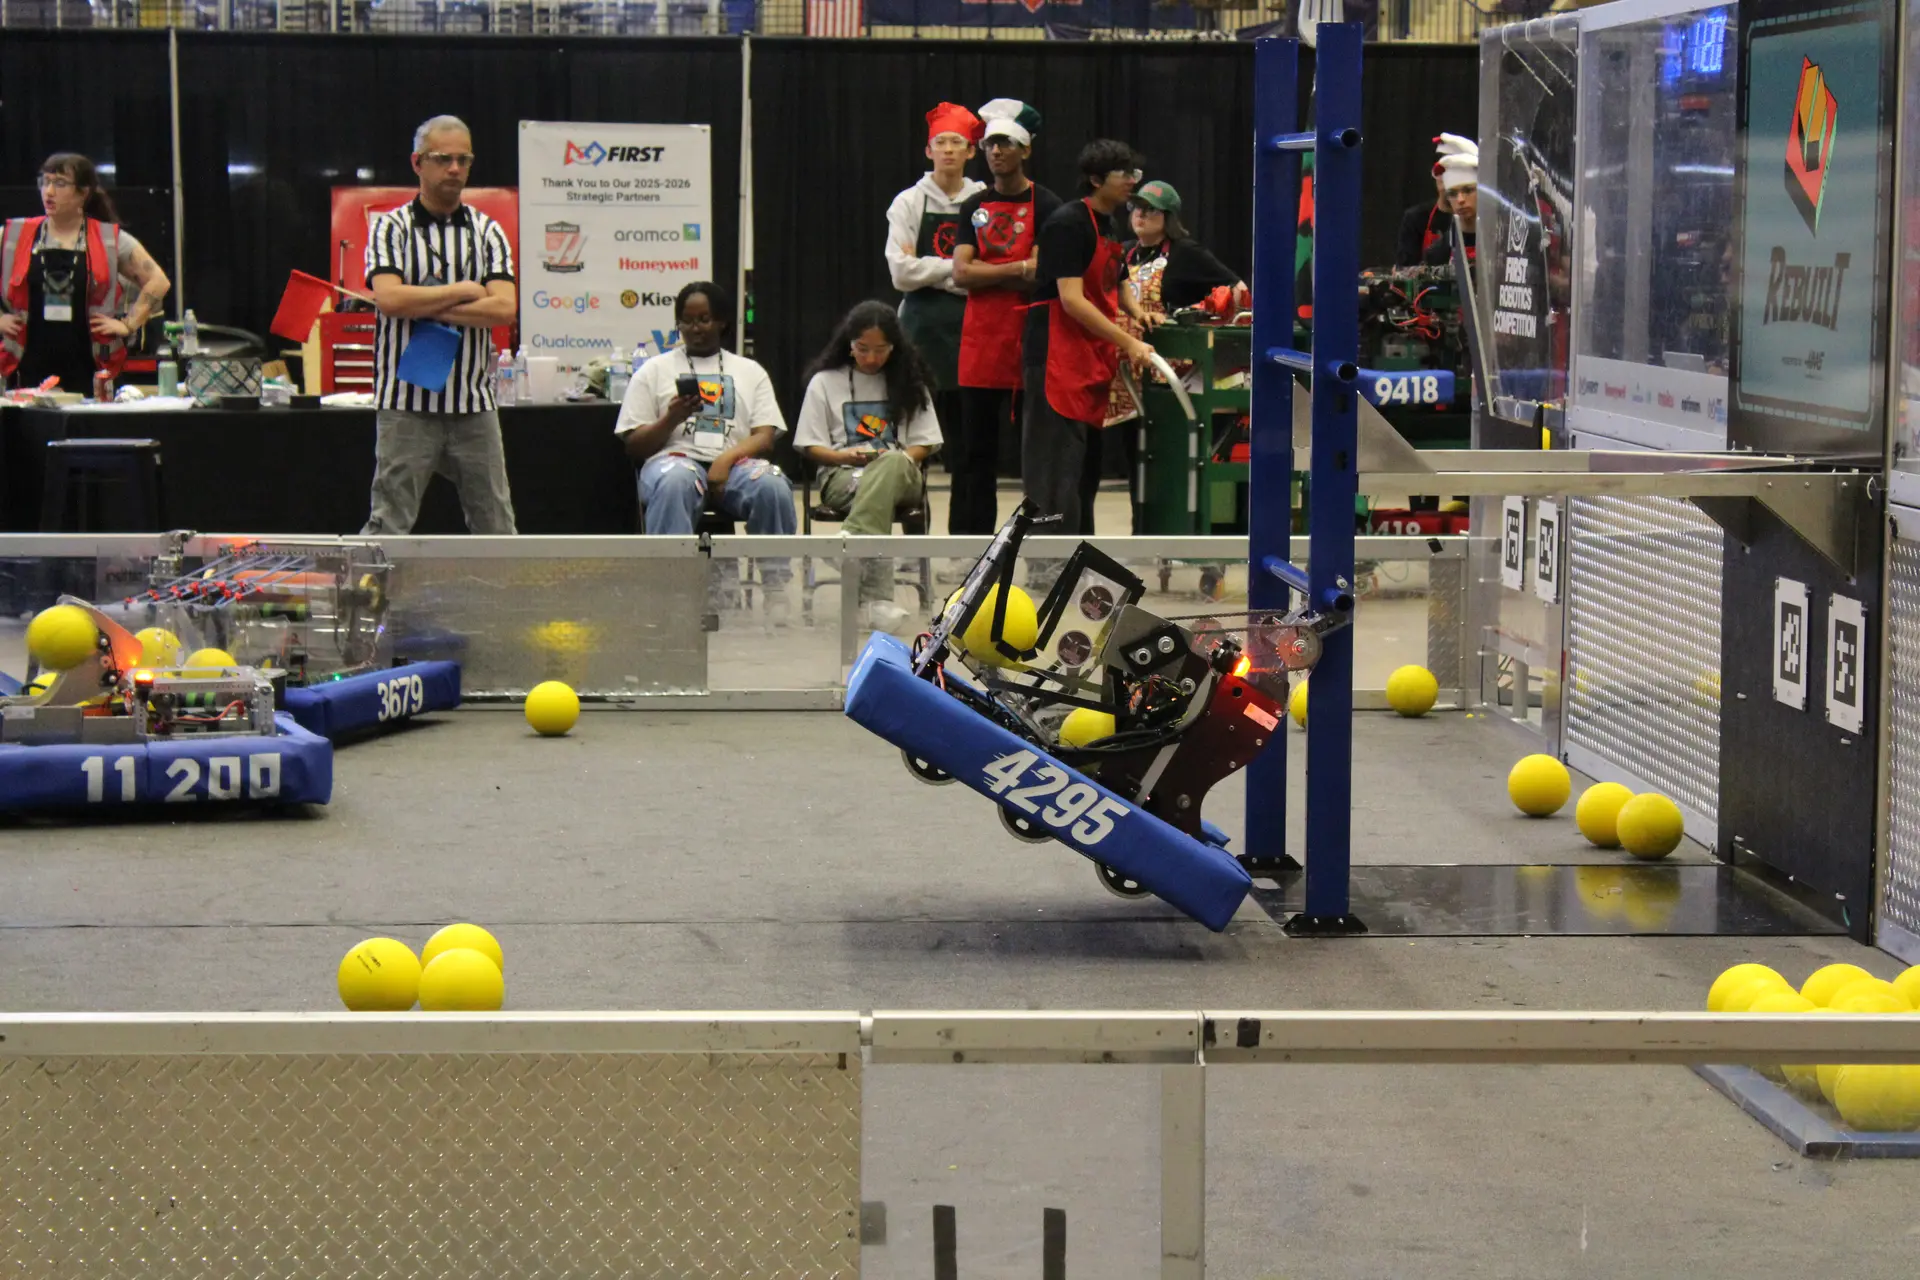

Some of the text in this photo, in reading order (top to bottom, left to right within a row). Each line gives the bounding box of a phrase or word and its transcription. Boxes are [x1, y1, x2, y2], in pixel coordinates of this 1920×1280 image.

[607, 147, 665, 162] FIRST
[541, 178, 691, 189] Thank You to Our 2025-2026
[566, 191, 661, 203] Strategic Partners
[614, 229, 680, 242] aramco
[619, 257, 698, 273] Honeywell
[1505, 256, 1528, 284] FIRST
[533, 290, 600, 313] Google
[1499, 284, 1532, 311] ROBOTICS
[1494, 310, 1537, 339] COMPETITION
[532, 333, 613, 349] Qualcomm
[1374, 375, 1439, 405] 9418
[377, 674, 424, 722] 3679
[982, 748, 1131, 846] 4295
